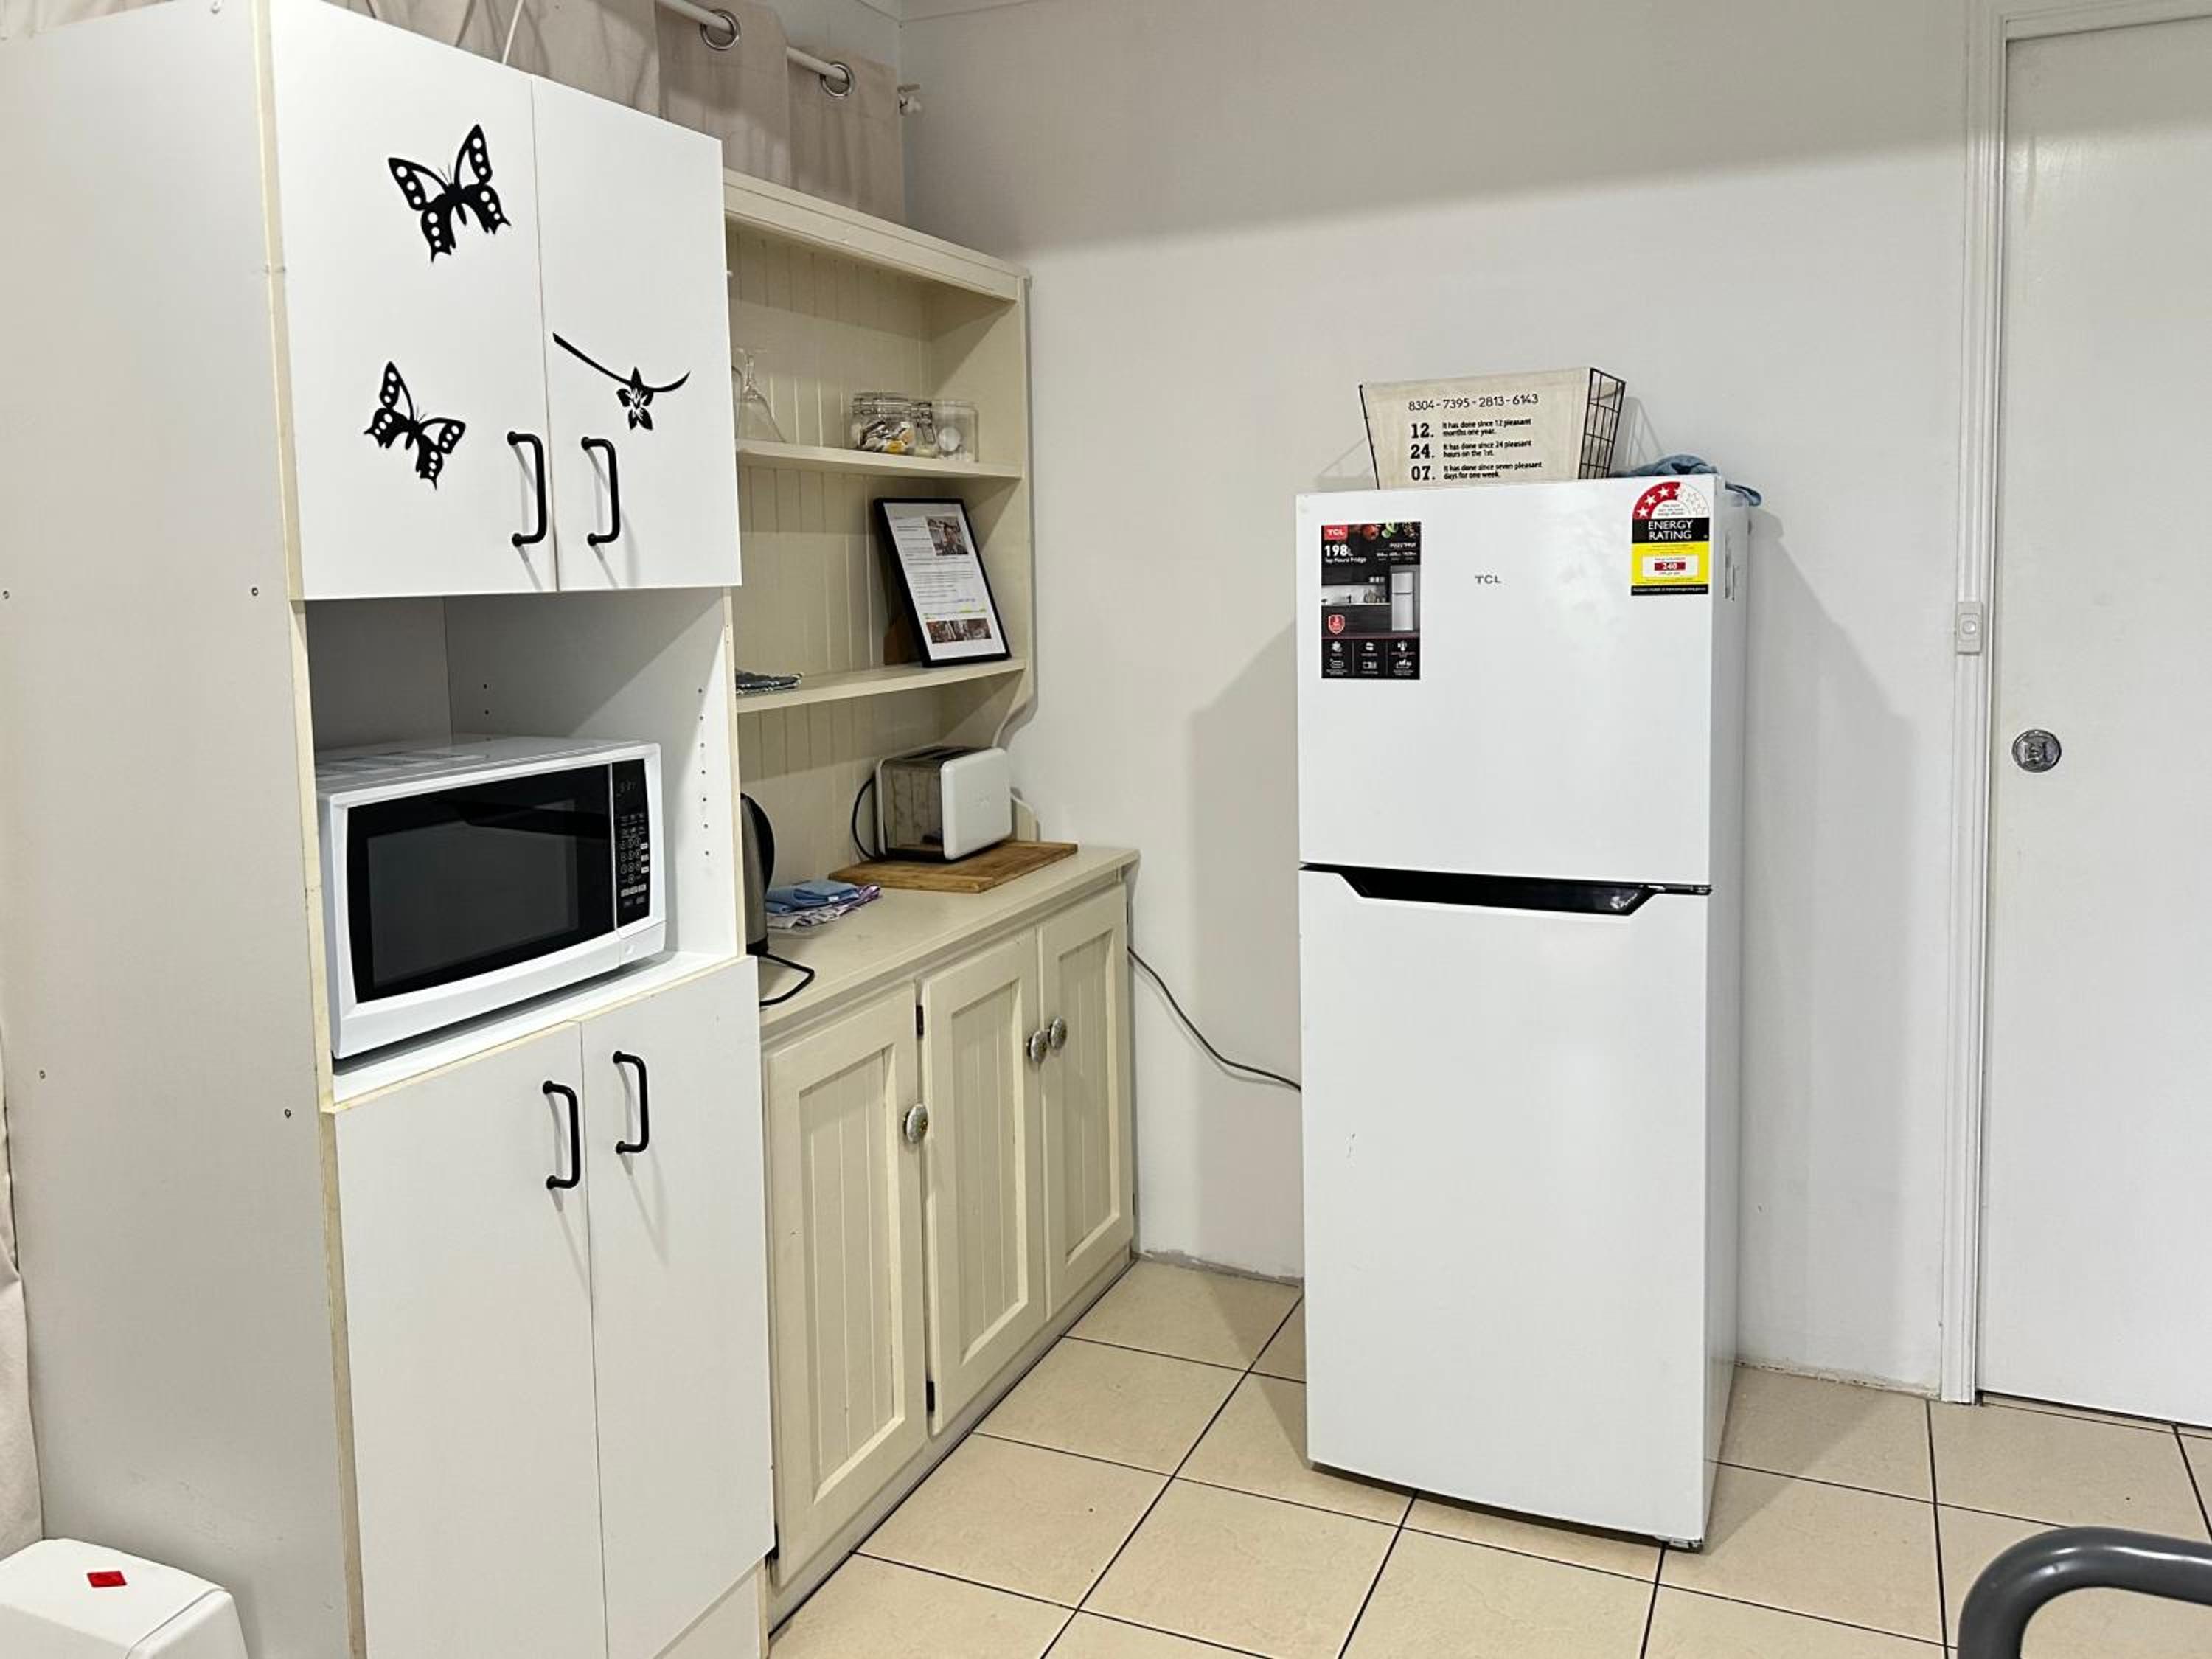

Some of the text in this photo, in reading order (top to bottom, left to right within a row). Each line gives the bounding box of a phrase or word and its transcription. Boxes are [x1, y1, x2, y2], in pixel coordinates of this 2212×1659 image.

[1503, 418, 1531, 428] pleasant
[1411, 422, 1434, 439] 12.
[1442, 428, 1467, 437] months
[1503, 440, 1531, 448] pleasant
[1410, 443, 1435, 459] 24.
[1478, 463, 1495, 471] since
[1514, 462, 1543, 471] pleasant
[1411, 465, 1436, 481] 07.
[1443, 473, 1458, 481] days
[1648, 520, 1693, 530] ENERGY
[1327, 529, 1345, 537] TCL
[1649, 531, 1692, 540] RATING
[1475, 574, 1502, 584] TCL
